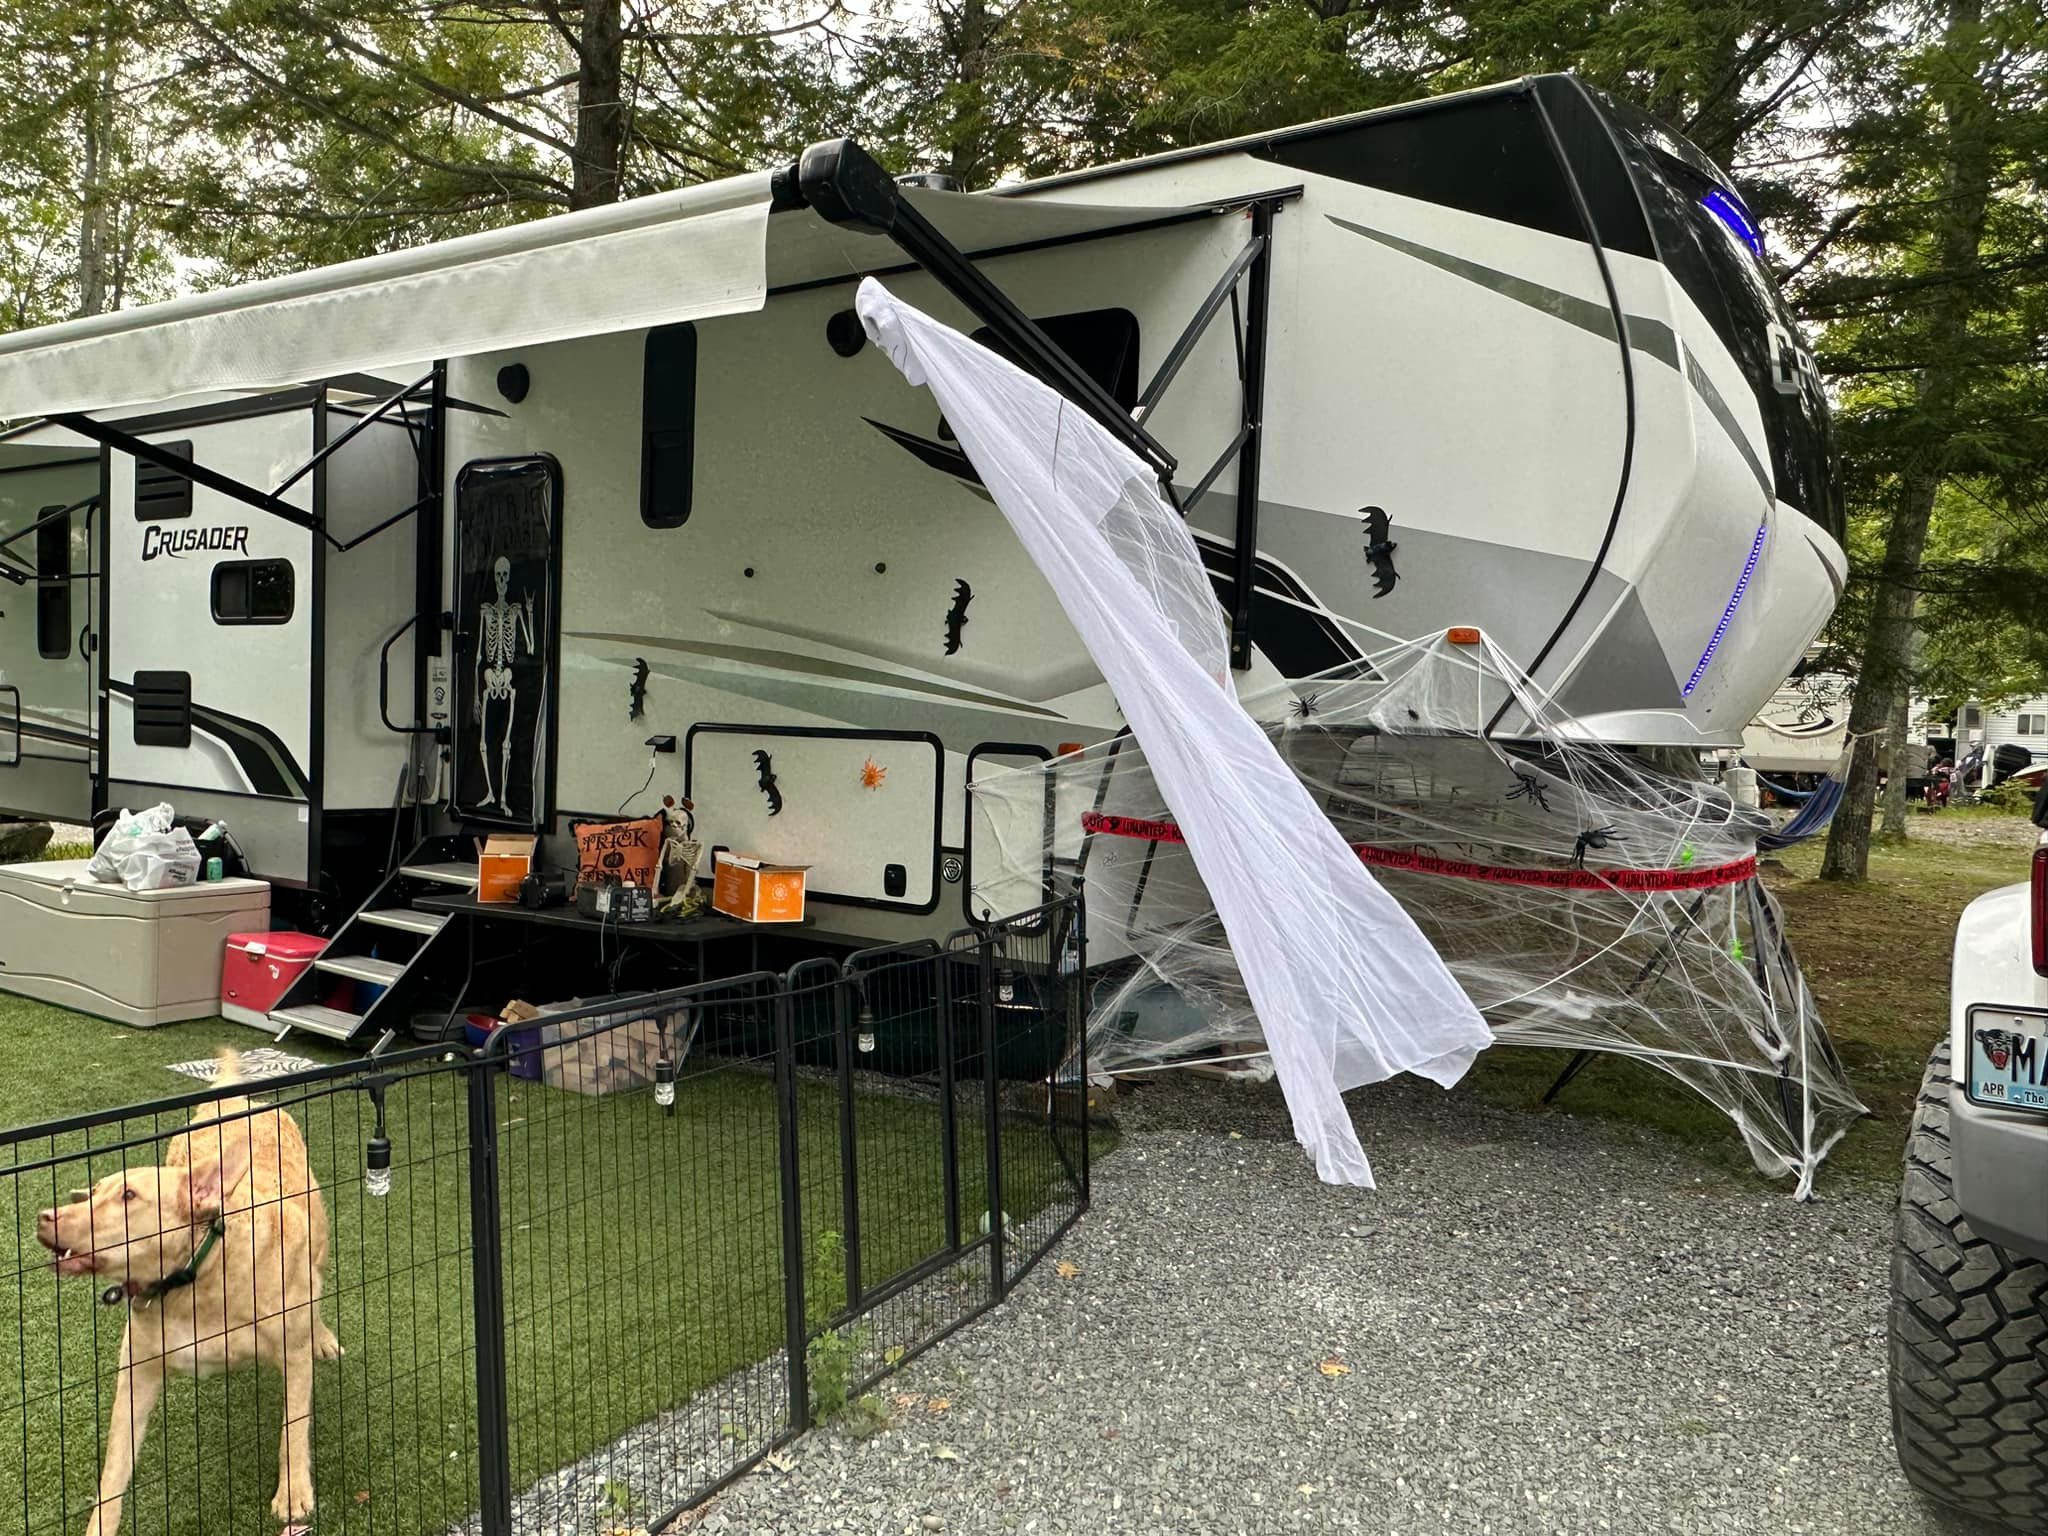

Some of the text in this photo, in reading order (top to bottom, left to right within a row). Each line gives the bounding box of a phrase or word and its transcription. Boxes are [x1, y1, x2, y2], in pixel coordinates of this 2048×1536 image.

[142, 525, 250, 561] CRUSADER
[583, 829, 649, 852] TRICK
[1982, 1082, 2004, 1096] APR
[2025, 1091, 2045, 1104] The
